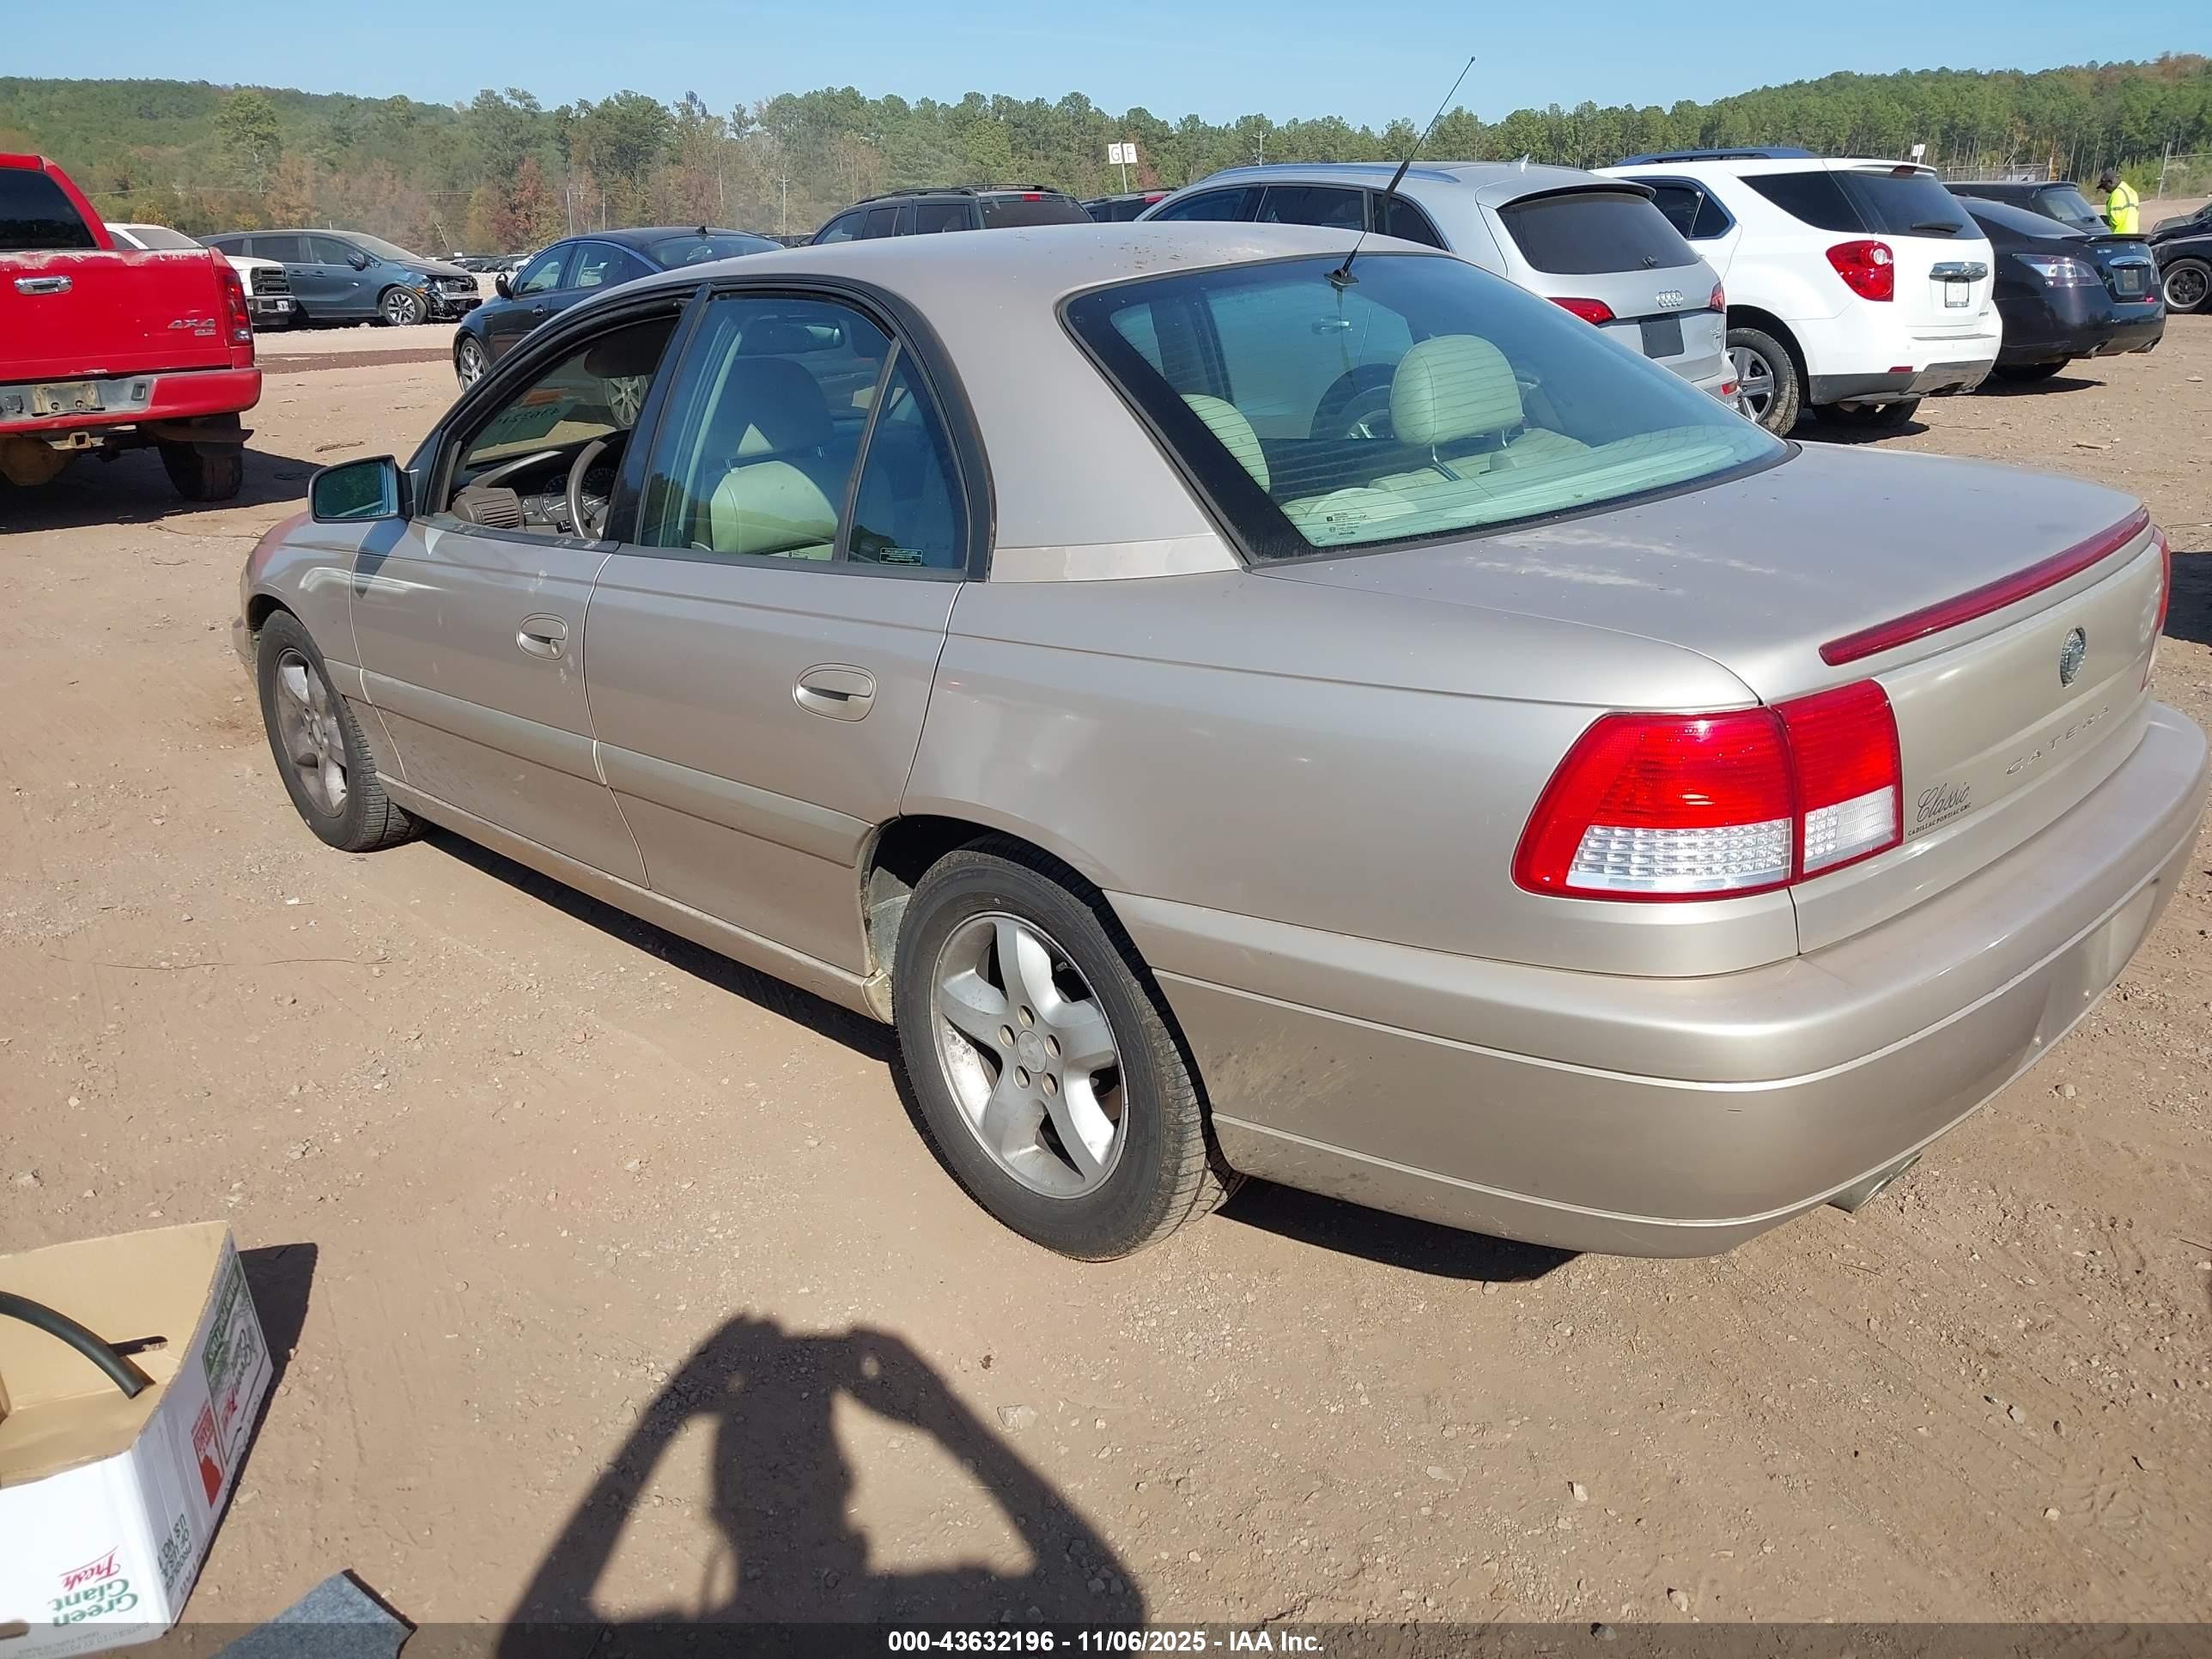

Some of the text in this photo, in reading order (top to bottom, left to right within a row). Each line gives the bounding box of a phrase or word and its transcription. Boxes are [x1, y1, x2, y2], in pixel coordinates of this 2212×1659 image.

[1111, 146, 1121, 161] G
[1126, 146, 1133, 161] F
[2006, 705, 2110, 775] CATERA
[1917, 782, 1971, 823] Classic
[1907, 819, 1936, 836] CADILLAC
[62, 1551, 121, 1591] Fresh
[52, 1578, 129, 1612] Giant
[53, 1593, 138, 1627] Green
